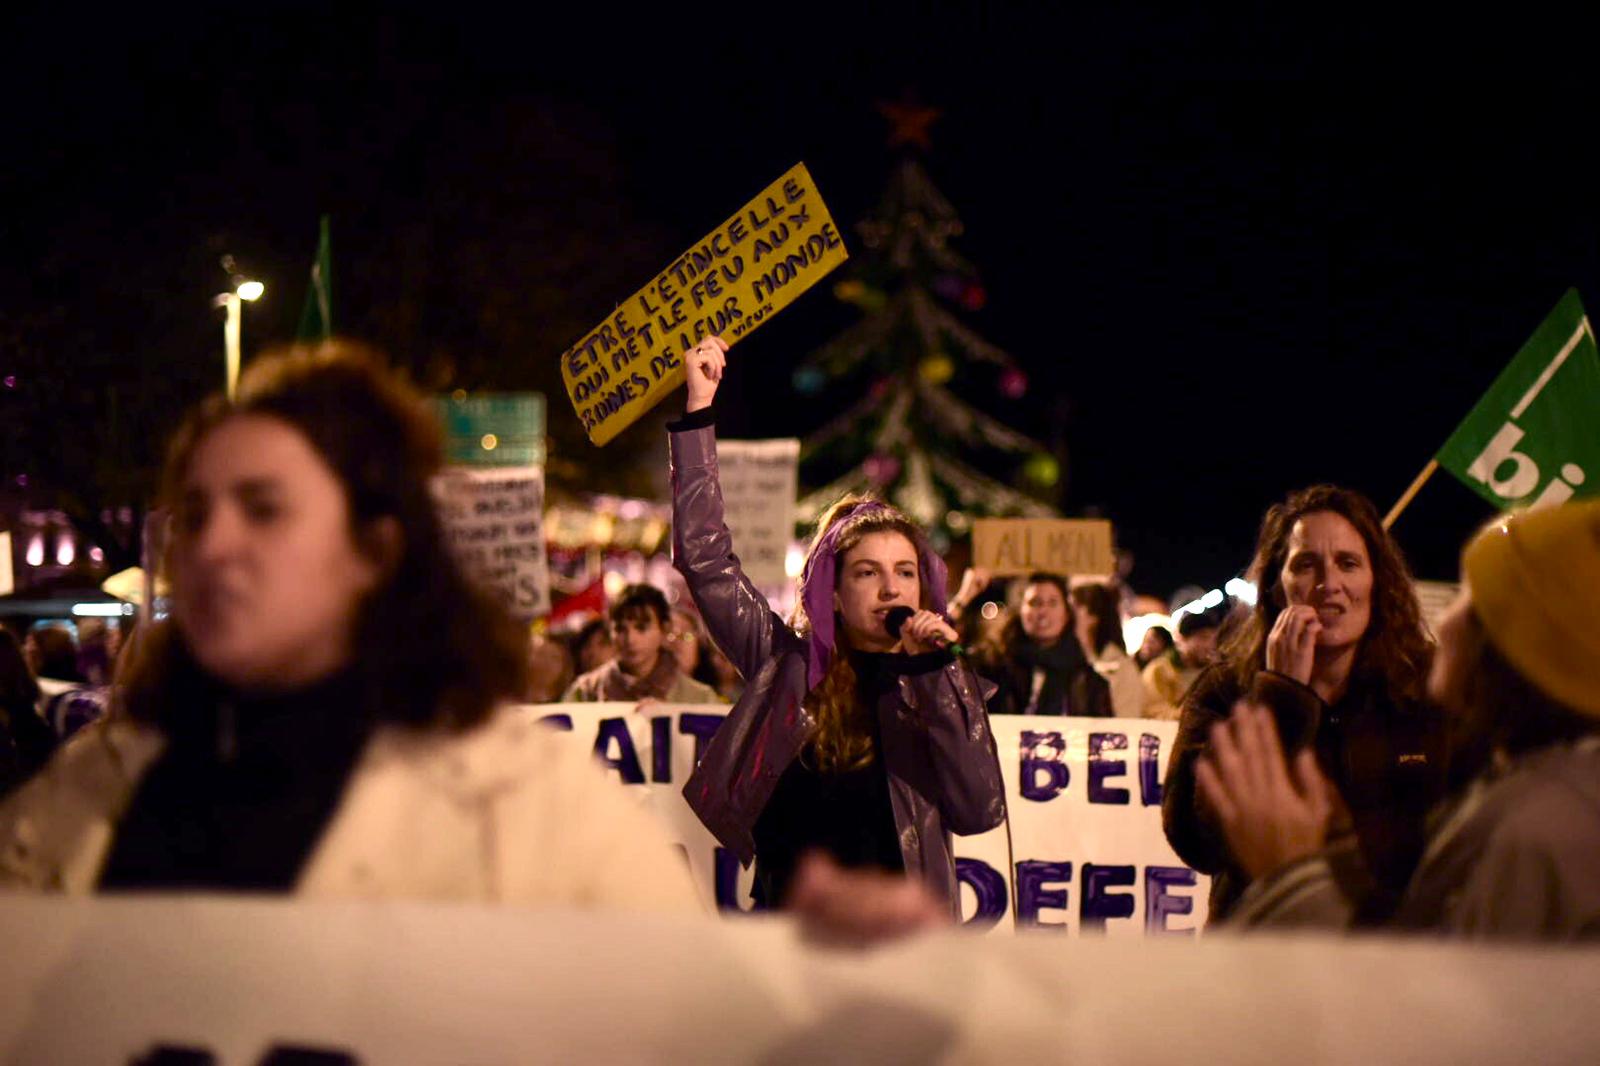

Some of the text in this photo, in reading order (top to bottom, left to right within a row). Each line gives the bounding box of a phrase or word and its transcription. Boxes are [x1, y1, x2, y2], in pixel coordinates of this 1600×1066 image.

[612, 322, 653, 372] MET
[659, 297, 688, 334] LE
[691, 255, 744, 310] FEU
[754, 204, 810, 263] AUX
[650, 346, 680, 380] DE
[752, 222, 840, 303] MONDE
